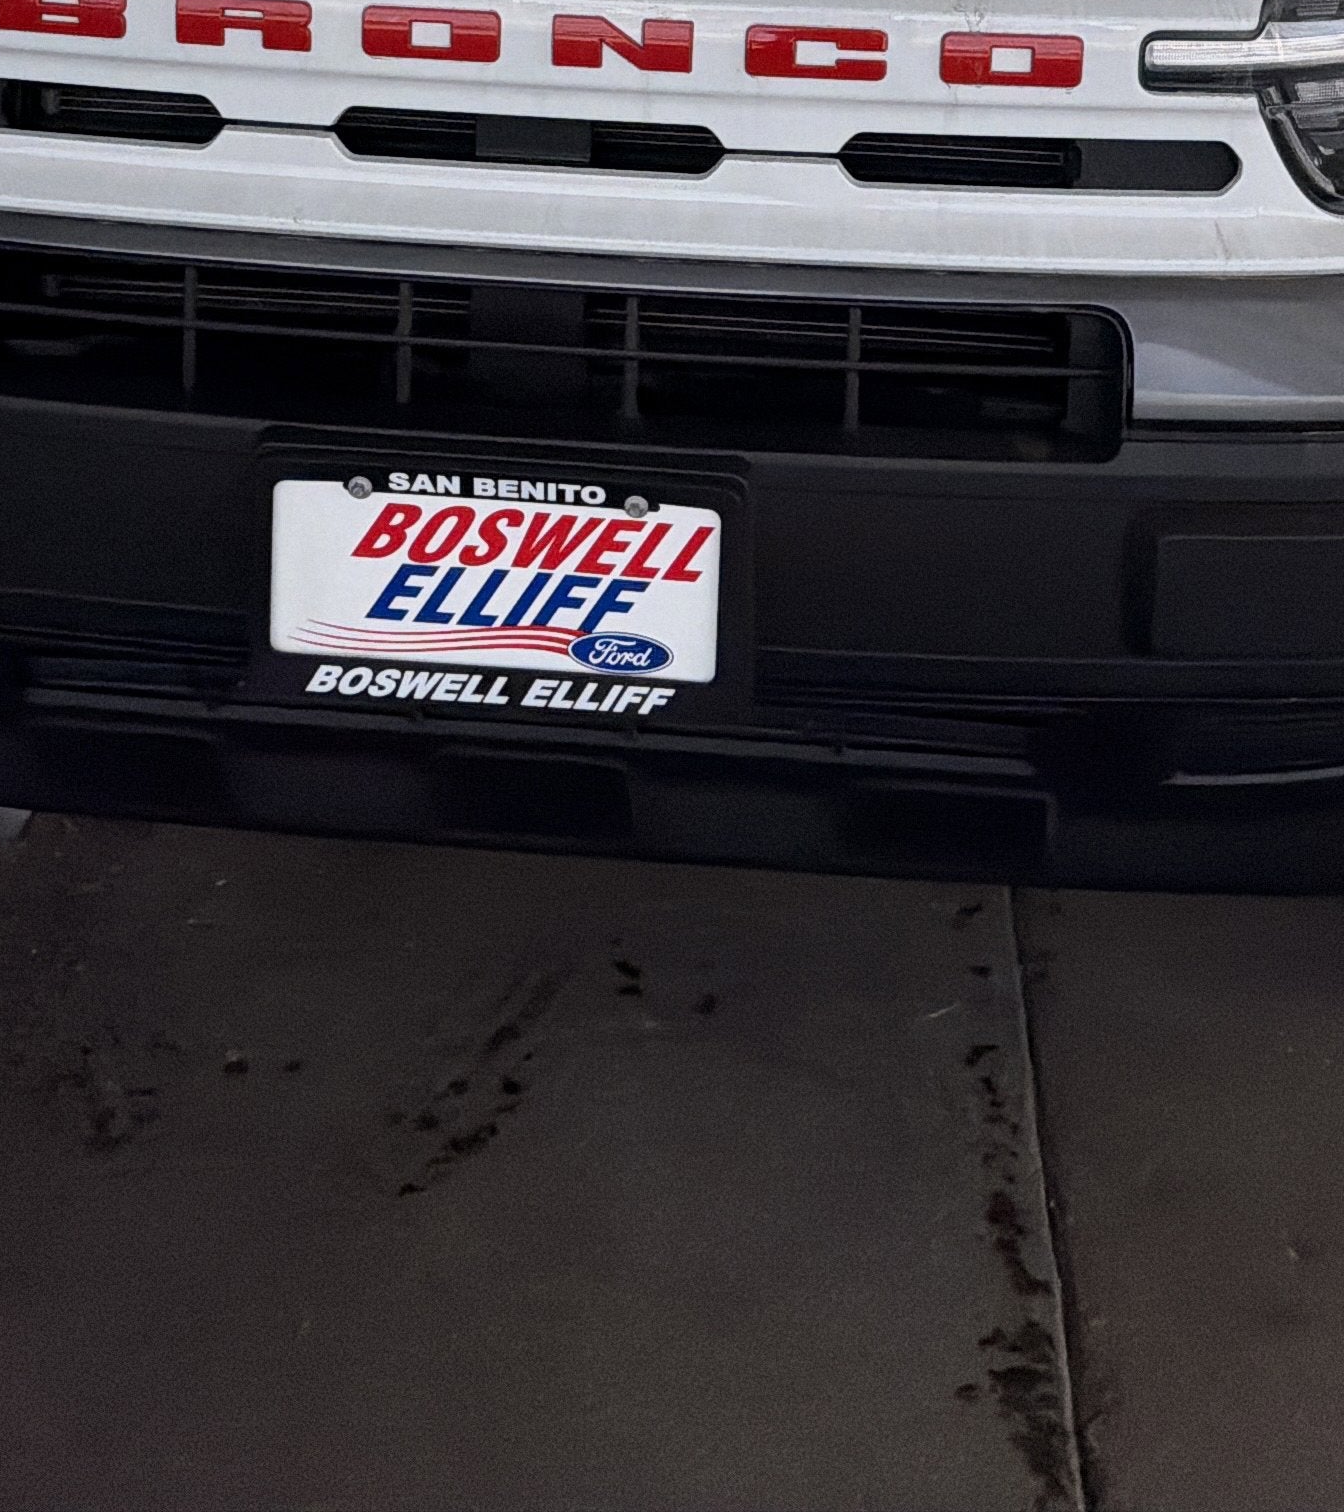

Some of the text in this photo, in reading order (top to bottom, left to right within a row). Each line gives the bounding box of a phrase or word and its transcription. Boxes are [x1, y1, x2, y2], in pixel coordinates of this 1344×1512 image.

[388, 471, 607, 505] SAN BENITO
[351, 502, 715, 583] BOSWELL
[365, 563, 651, 634] ELLIFF
[588, 641, 653, 668] Ford
[305, 664, 676, 716] BOSWELL ELLIFF
